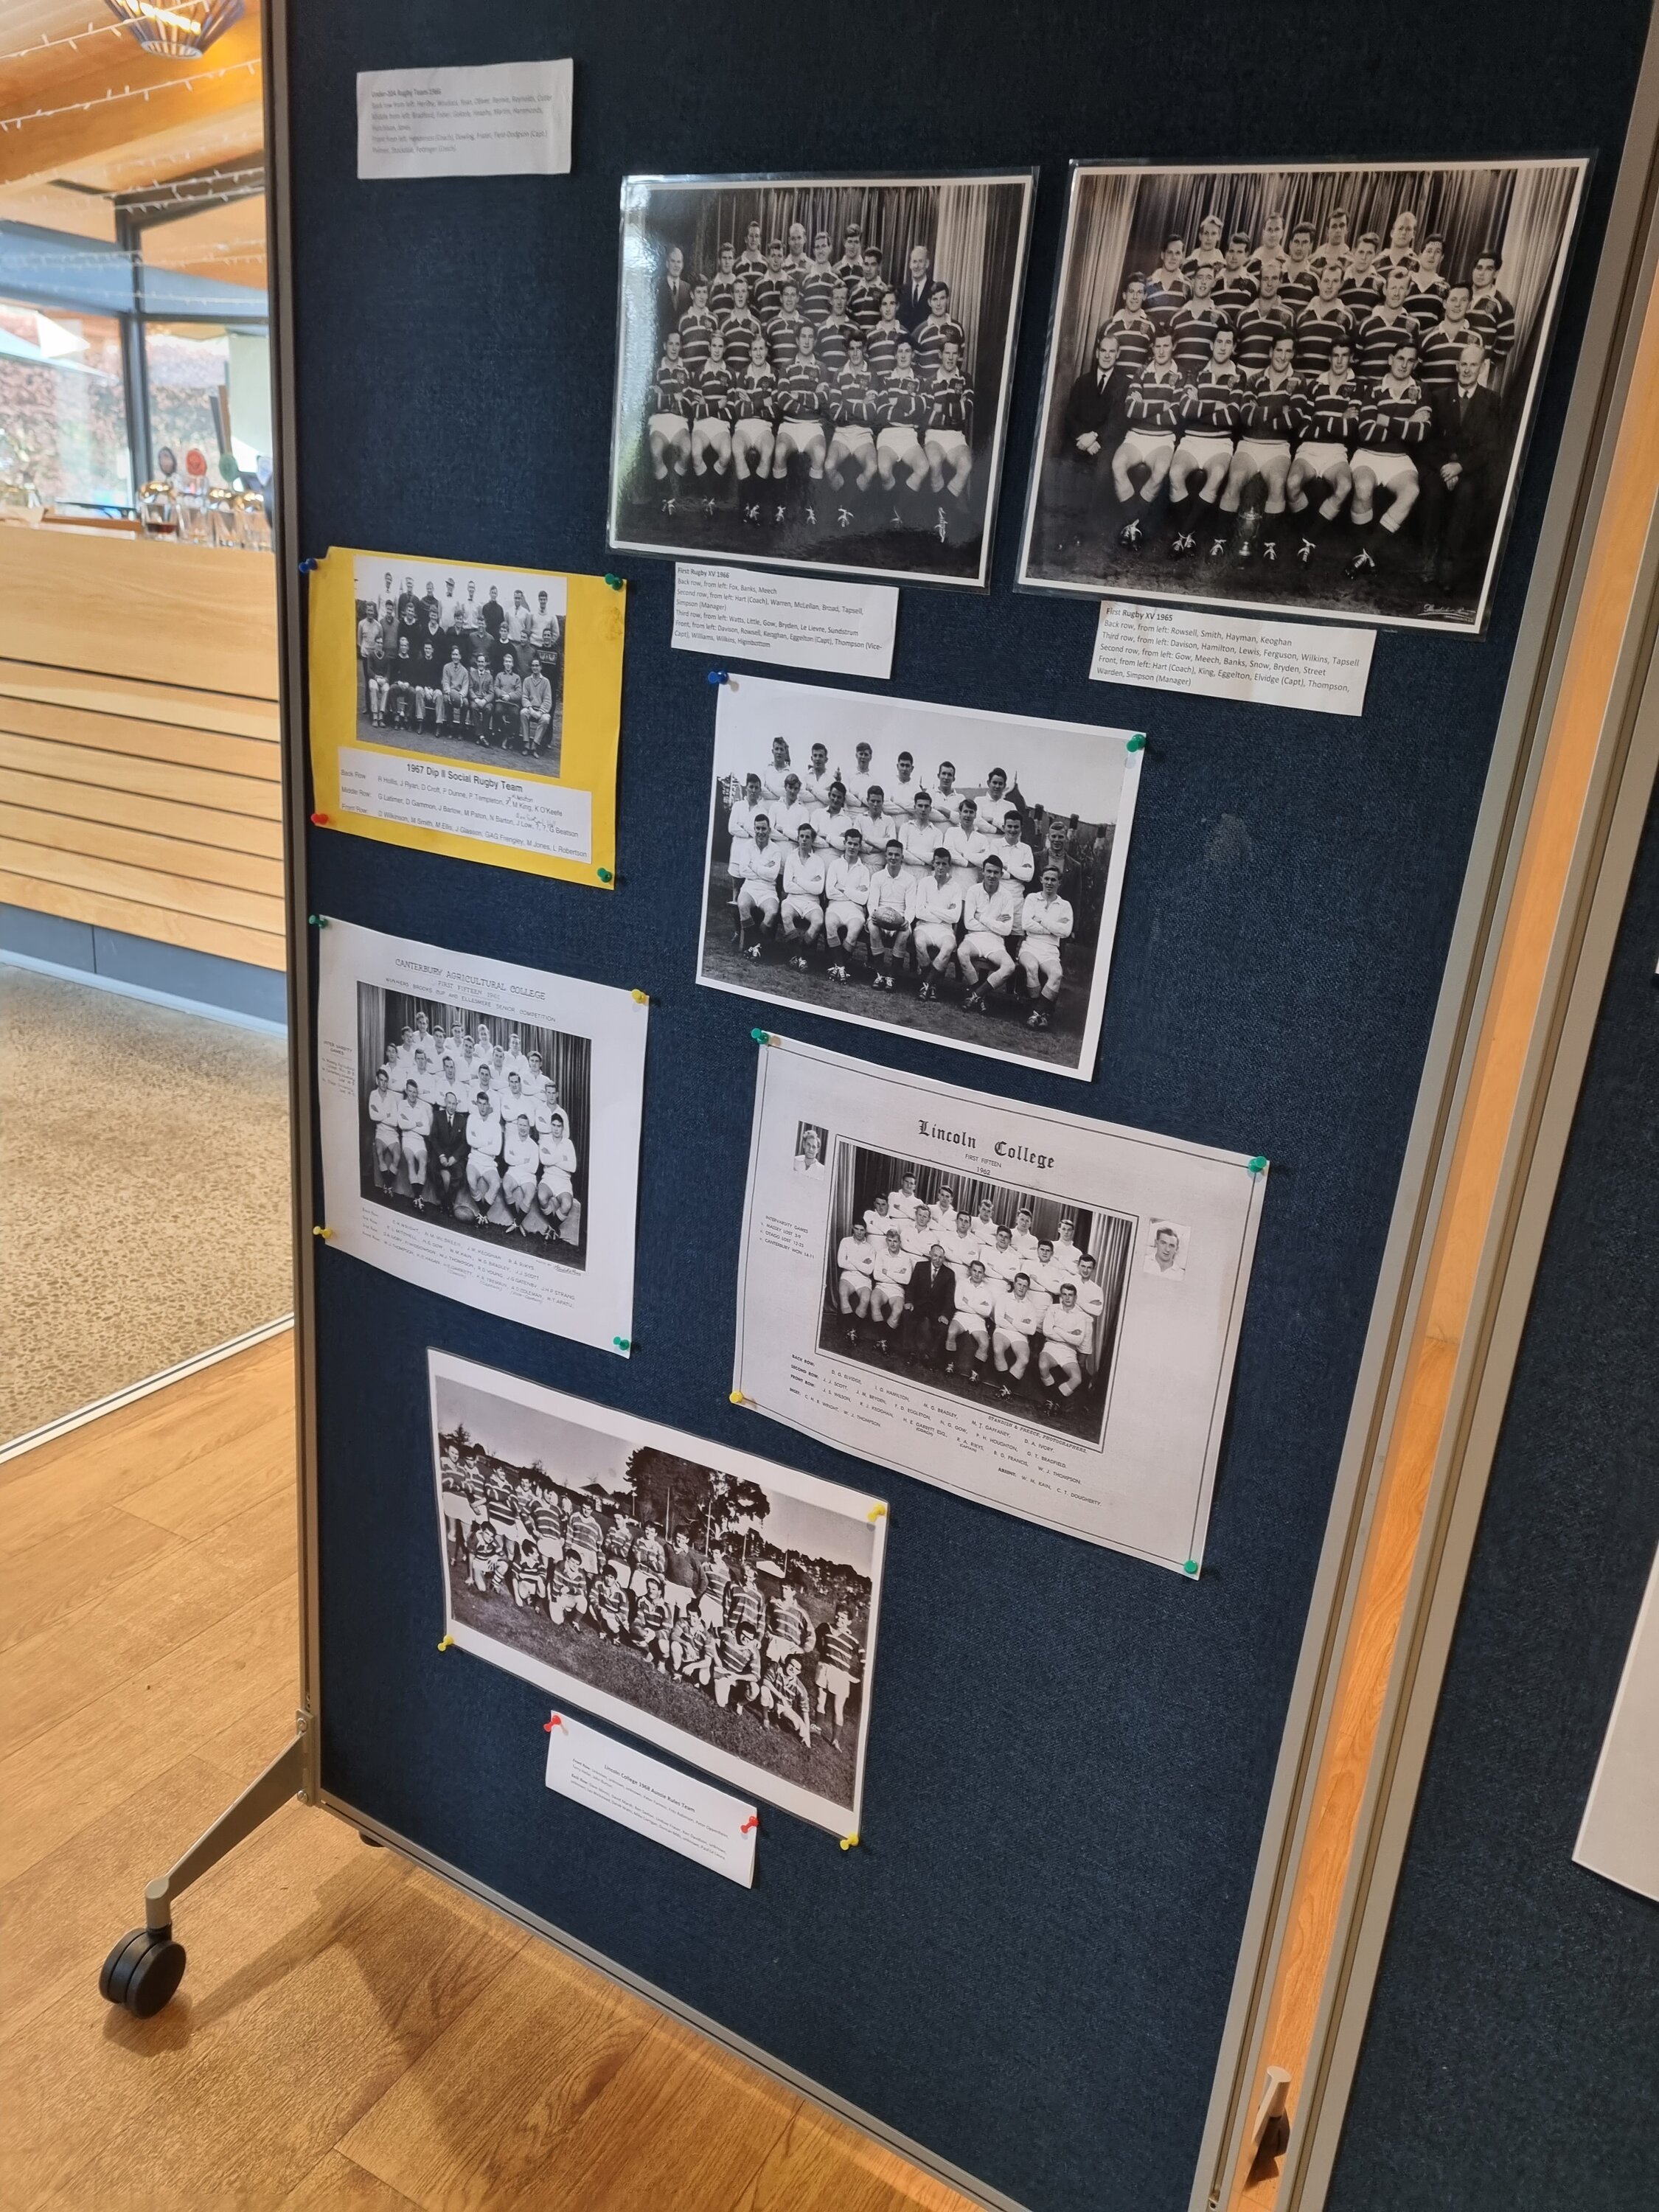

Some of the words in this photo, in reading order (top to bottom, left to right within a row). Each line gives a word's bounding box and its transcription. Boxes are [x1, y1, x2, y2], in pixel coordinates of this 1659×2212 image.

[690, 568, 707, 577] Rugby
[703, 580, 717, 590] from
[717, 581, 728, 591] left:
[728, 582, 740, 591] Fox,
[740, 584, 757, 593] Banks,
[757, 586, 777, 594] Meech
[675, 598, 698, 607] Simpson
[698, 601, 726, 611] (Manager)
[676, 588, 695, 596] Second
[709, 591, 723, 599] from
[747, 596, 769, 605] (Coach),
[770, 599, 793, 608] Warren,
[1105, 606, 1121, 616] First
[1121, 609, 1144, 619] Rugby
[728, 615, 746, 624] Watts,
[746, 617, 762, 626] Little,
[762, 619, 777, 627] Gow,
[778, 621, 799, 630] Bryden,
[807, 625, 827, 633] Lievre,
[1104, 619, 1119, 627] Back
[1120, 622, 1135, 630] row,
[1137, 623, 1155, 631] from
[1155, 625, 1169, 633] left:
[1170, 627, 1199, 637] Rowsell,
[1200, 630, 1223, 640] Smith,
[1225, 632, 1258, 644] Hayman,
[1259, 636, 1292, 646] Keoghan
[674, 630, 690, 639] Capt),
[675, 619, 691, 627] Front,
[692, 621, 705, 629] from
[717, 625, 740, 634] Davison,
[833, 638, 864, 648] Thompson
[865, 641, 883, 650] (Vice-
[1102, 631, 1120, 639] Third
[1136, 635, 1154, 644] from
[1155, 637, 1169, 646] left:
[1169, 639, 1199, 650] Davison,
[1200, 642, 1237, 654] Hamilton,
[1238, 646, 1262, 656] Lewis,
[1263, 649, 1298, 661] Ferguson,
[1301, 653, 1329, 664] Wilkins,
[1332, 656, 1360, 667] Tapsell
[1099, 643, 1124, 654] Second
[1124, 647, 1140, 655] row,
[1141, 647, 1158, 656] from
[1160, 650, 1174, 658] left:
[1175, 652, 1192, 661] Gow,
[1194, 654, 1221, 664] Meech,
[1223, 657, 1247, 667] Banks,
[1248, 660, 1271, 670] Snow,
[1273, 662, 1301, 674] Bryden,
[1302, 666, 1326, 675] Street
[1096, 667, 1124, 678] Warden,
[1125, 670, 1154, 681] Simpson
[1155, 674, 1191, 686] (Manager)
[1098, 655, 1118, 664] Front,
[1119, 657, 1135, 666] from
[1136, 659, 1151, 668] left:
[1152, 661, 1167, 670] Hart
[1168, 664, 1196, 674] (Coach),
[1197, 667, 1215, 677] King,
[1217, 669, 1252, 681] Eggelton,
[1253, 672, 1279, 684] Elvidge
[1281, 675, 1306, 687] (Capt),
[1307, 679, 1349, 692] Thompson,
[406, 763, 424, 773] 1967
[426, 766, 439, 778] Dip
[447, 771, 471, 782] Social
[473, 775, 498, 790] Rugby
[500, 780, 523, 792] Team
[394, 959, 442, 975] CANTERBURY
[445, 971, 507, 990] AGRICULTURAL
[509, 985, 546, 1000] COLLEGE
[437, 980, 454, 989] FIRST
[456, 984, 482, 995] FIFTEEN
[917, 1119, 976, 1148] Lincoln
[994, 1141, 1054, 1168] College
[964, 1153, 978, 1161] FIRST
[981, 1158, 1001, 1167] FIFTEEN
[976, 1166, 990, 1175] 1962
[765, 1215, 793, 1228] INTERVARSITY
[793, 1225, 808, 1234] GAMES
